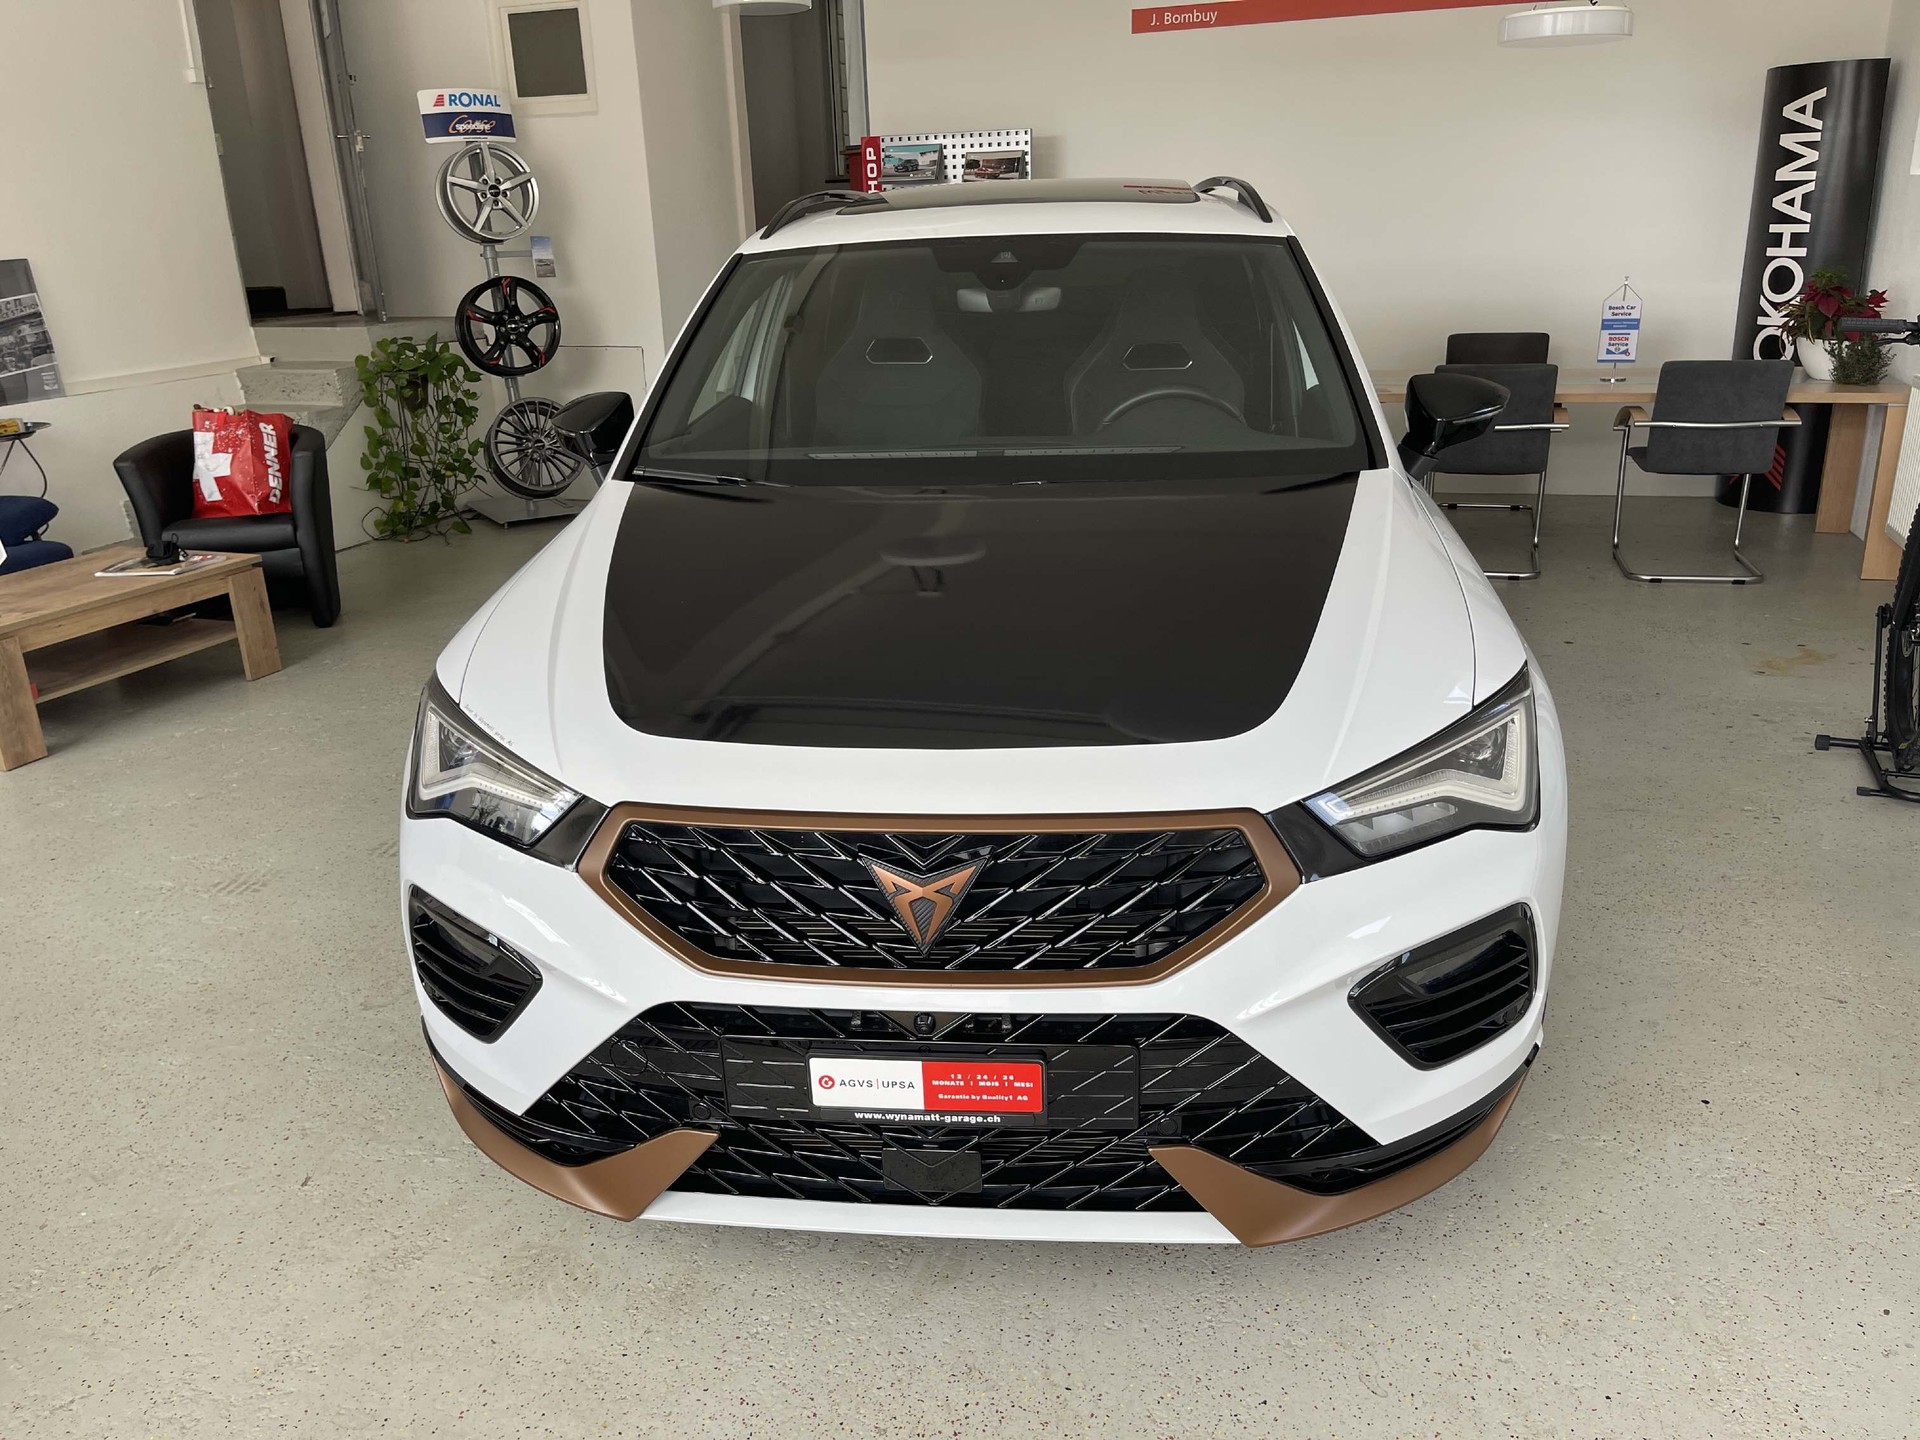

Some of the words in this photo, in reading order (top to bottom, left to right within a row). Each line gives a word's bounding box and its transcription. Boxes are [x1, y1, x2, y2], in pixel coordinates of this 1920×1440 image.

[1150, 13, 1160, 26] J.
[1164, 9, 1218, 25] Bombuy
[448, 92, 501, 108] RONAL
[865, 147, 880, 194] HOP
[1752, 87, 1828, 360] OKOHAMA
[258, 422, 283, 505] DENNER
[839, 1078, 874, 1088] AGVS
[881, 1080, 916, 1090] UPSA
[854, 1111, 1001, 1124] www.wynamatt-garage.ch
